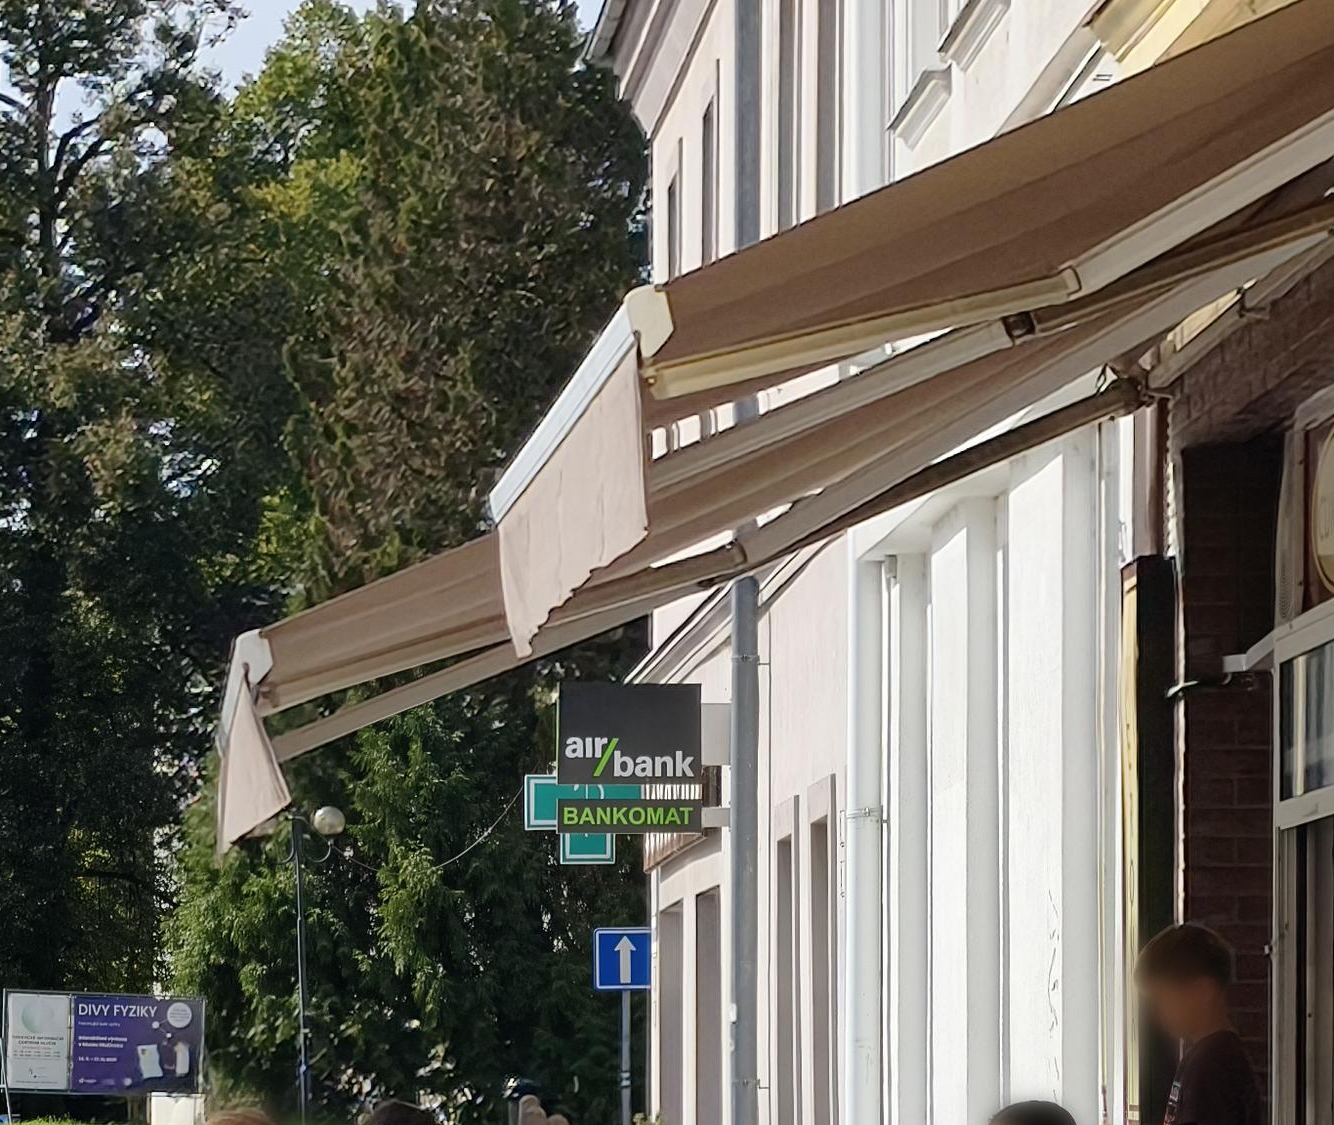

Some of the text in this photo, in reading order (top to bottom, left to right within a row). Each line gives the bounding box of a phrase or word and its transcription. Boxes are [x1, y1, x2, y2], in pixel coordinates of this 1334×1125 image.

[562, 806, 694, 826] BANKOMAT
[78, 1003, 110, 1017] DIVY
[113, 1005, 158, 1018] FYZIKY
